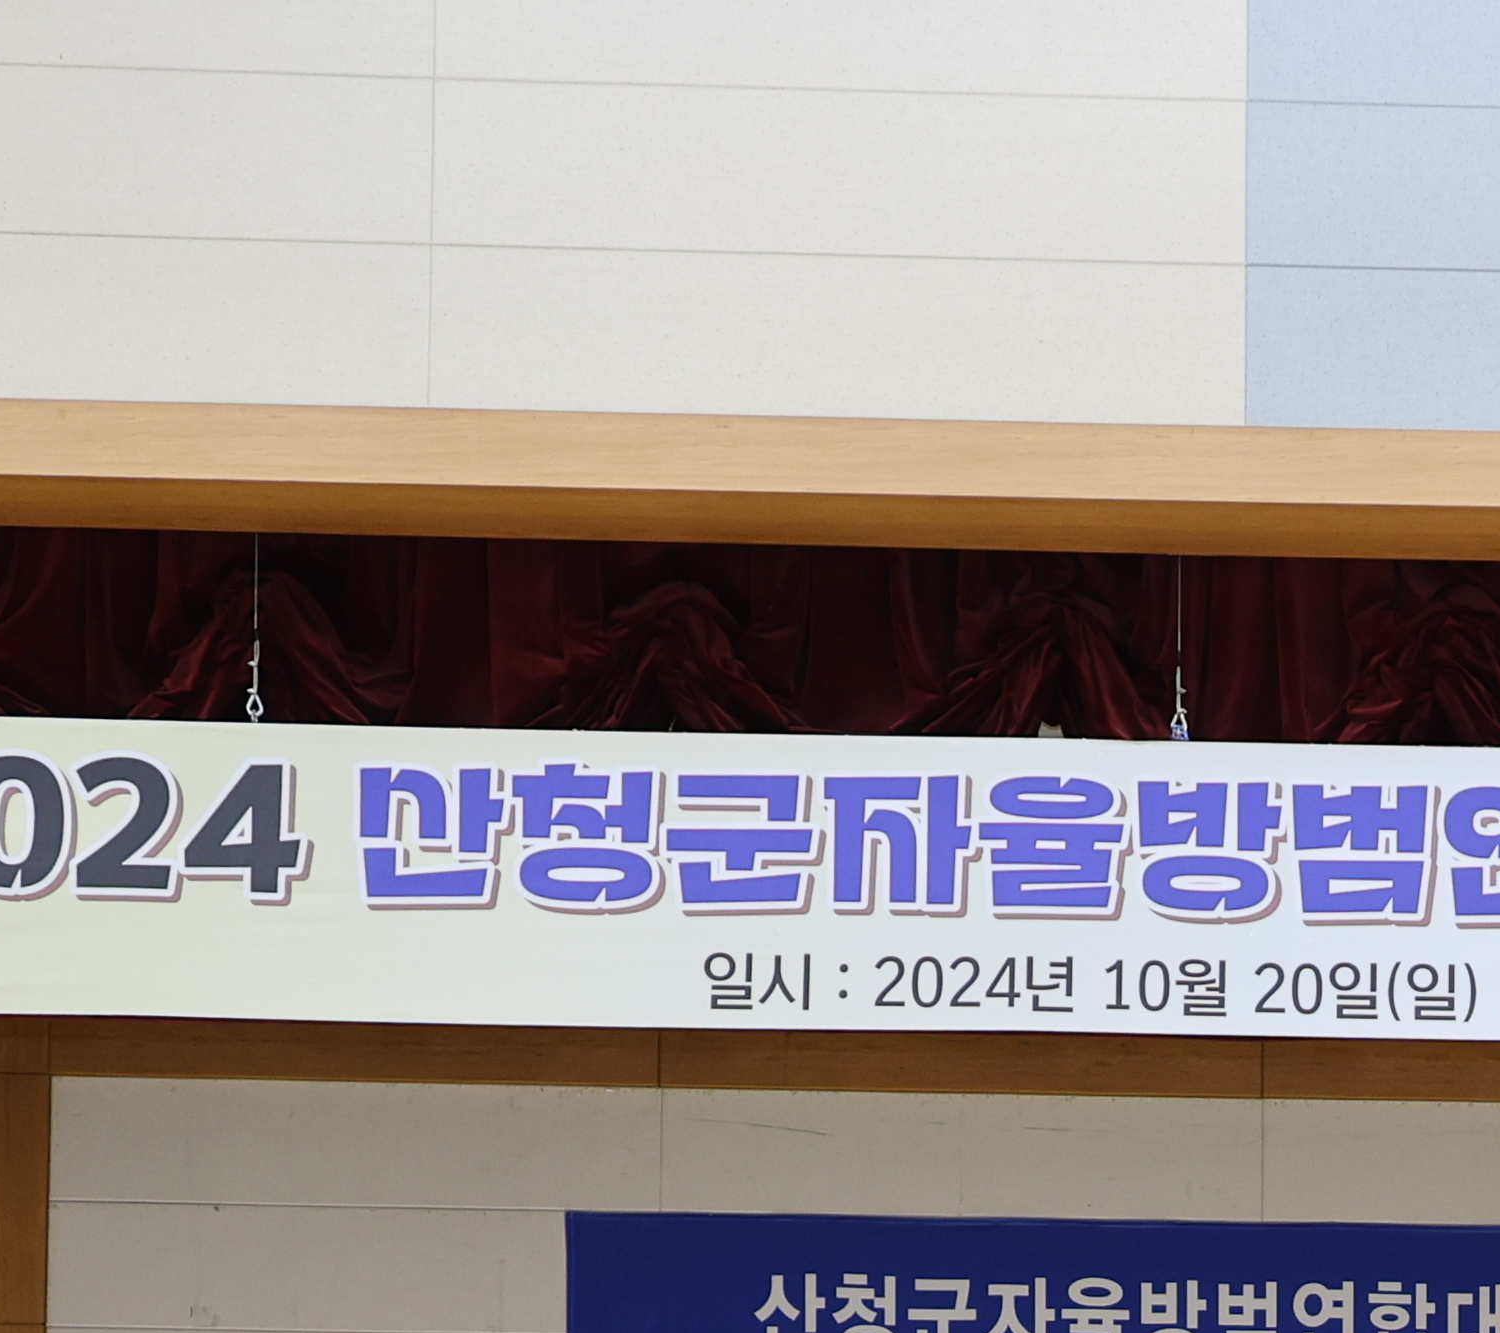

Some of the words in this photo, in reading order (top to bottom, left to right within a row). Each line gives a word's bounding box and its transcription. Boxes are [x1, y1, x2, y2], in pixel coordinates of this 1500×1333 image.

[704, 951, 812, 1010] 일시
[874, 955, 1075, 1014] 2024년
[1106, 961, 1228, 1018] 10월
[1255, 964, 1478, 1024] 20일(일)
